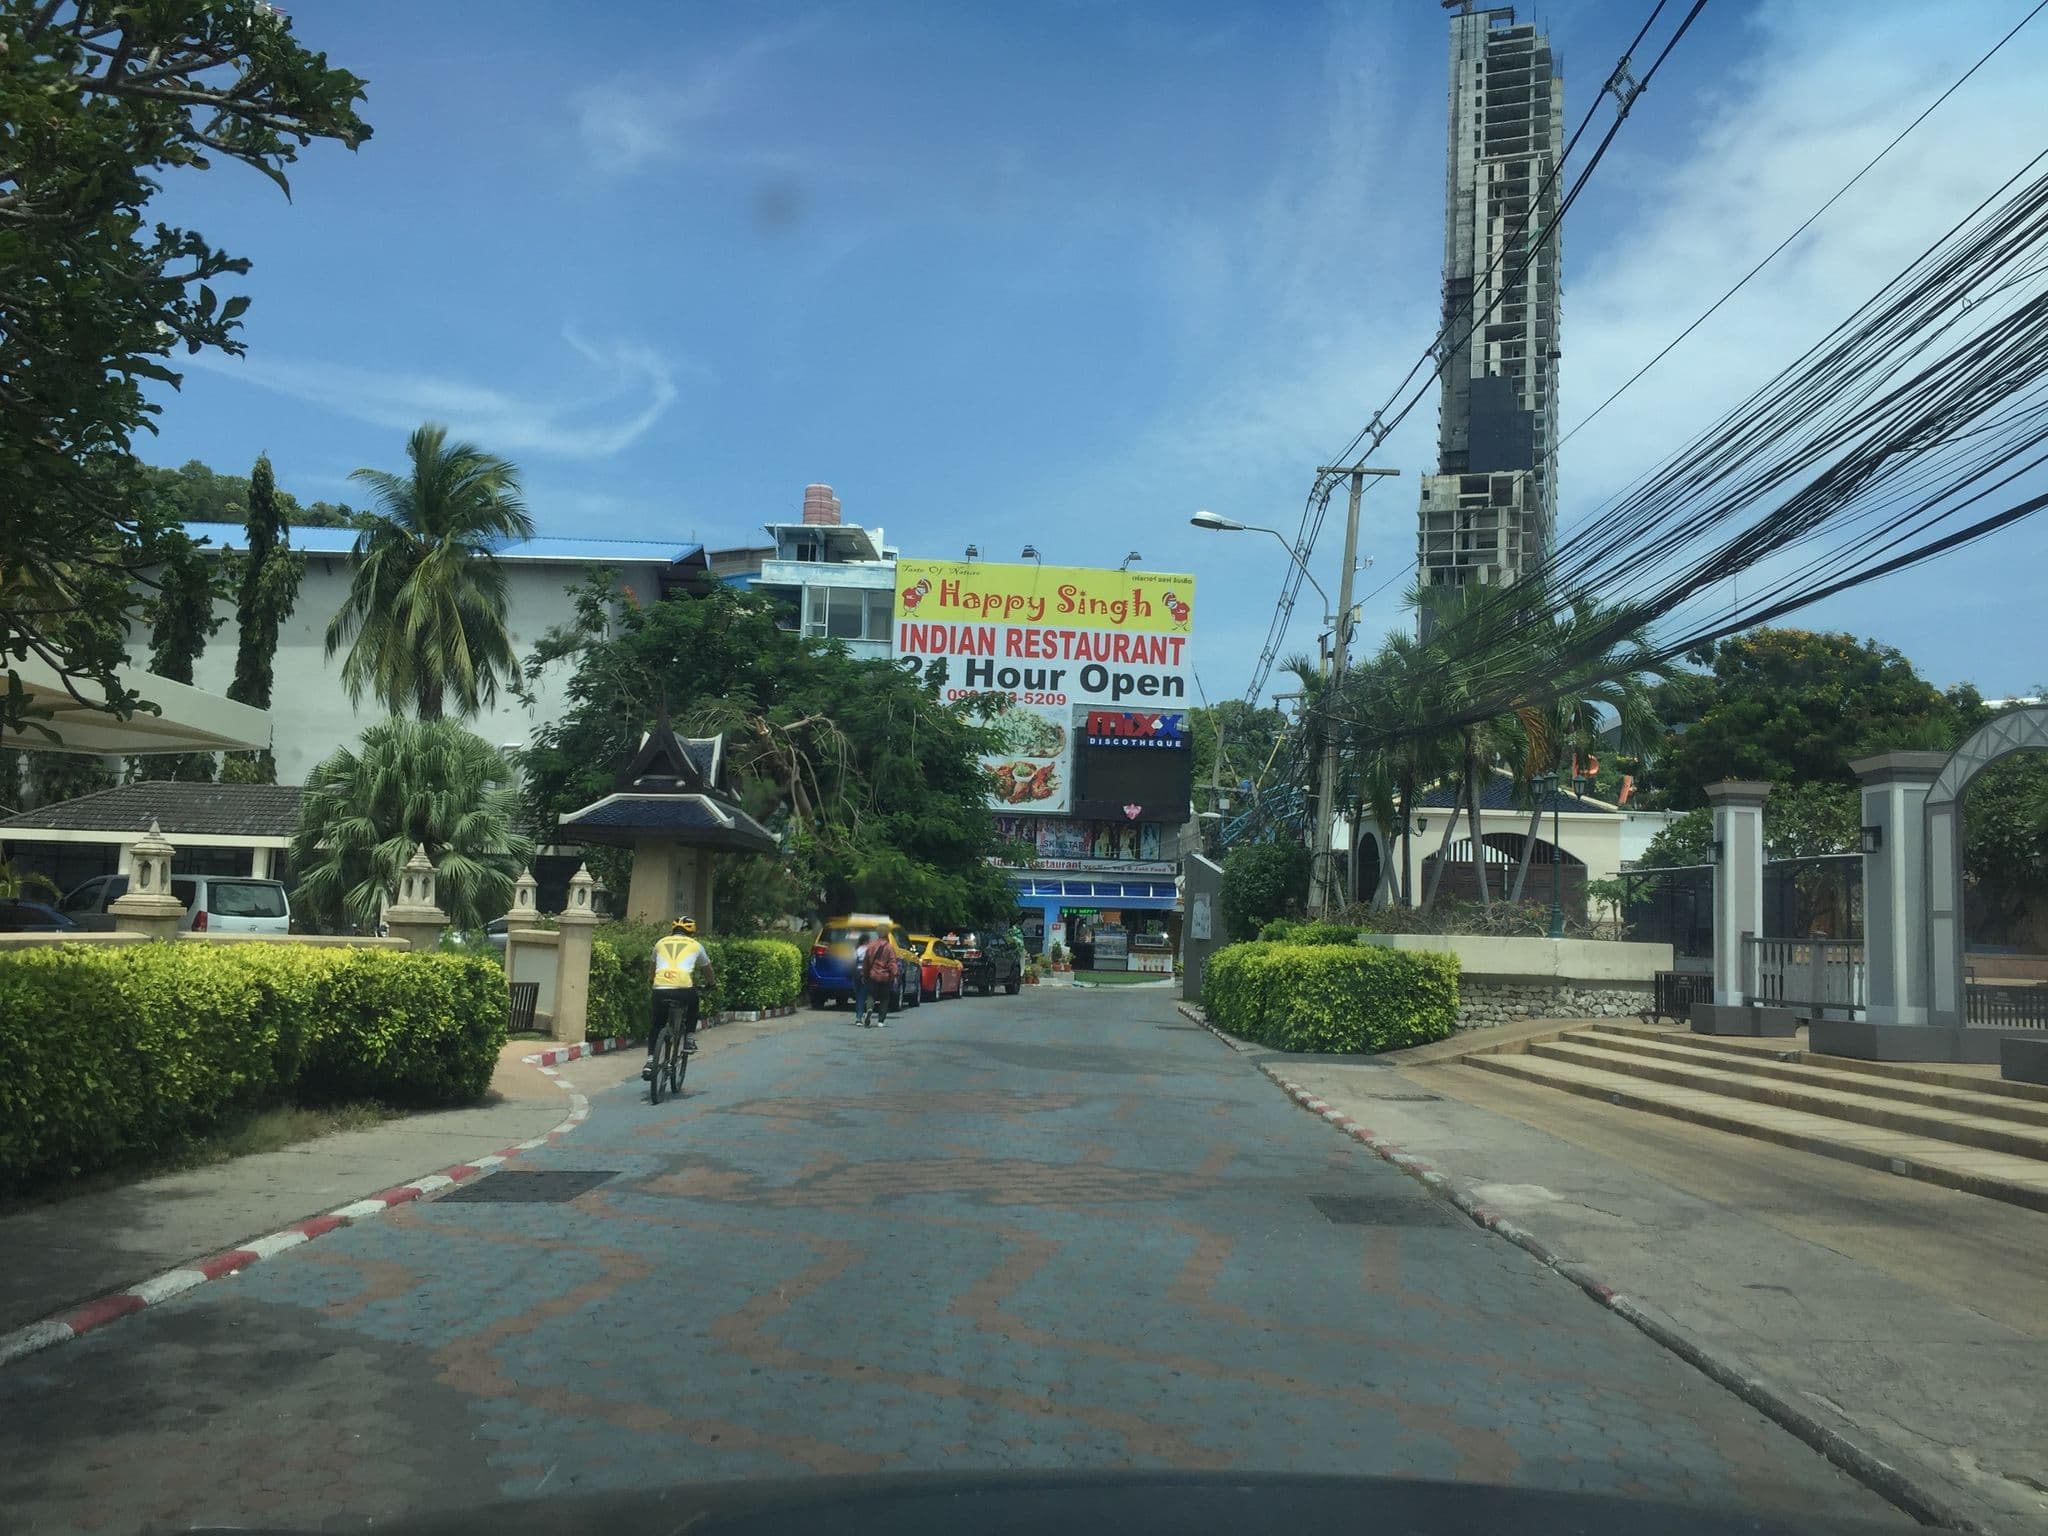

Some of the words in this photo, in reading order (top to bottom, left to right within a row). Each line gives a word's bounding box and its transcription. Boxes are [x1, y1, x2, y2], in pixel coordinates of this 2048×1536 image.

[928, 566, 943, 576] Of
[940, 579, 1046, 622] Happy
[1056, 584, 1152, 625] Singh
[899, 623, 996, 657] INDIAN
[1005, 627, 1186, 666] RESTAURANT
[901, 655, 950, 687] 24
[965, 658, 1067, 691] Hour
[1079, 663, 1185, 702] Open
[1089, 737, 1182, 748] DISCOTHEQUE
[1029, 859, 1082, 870] estaurant
